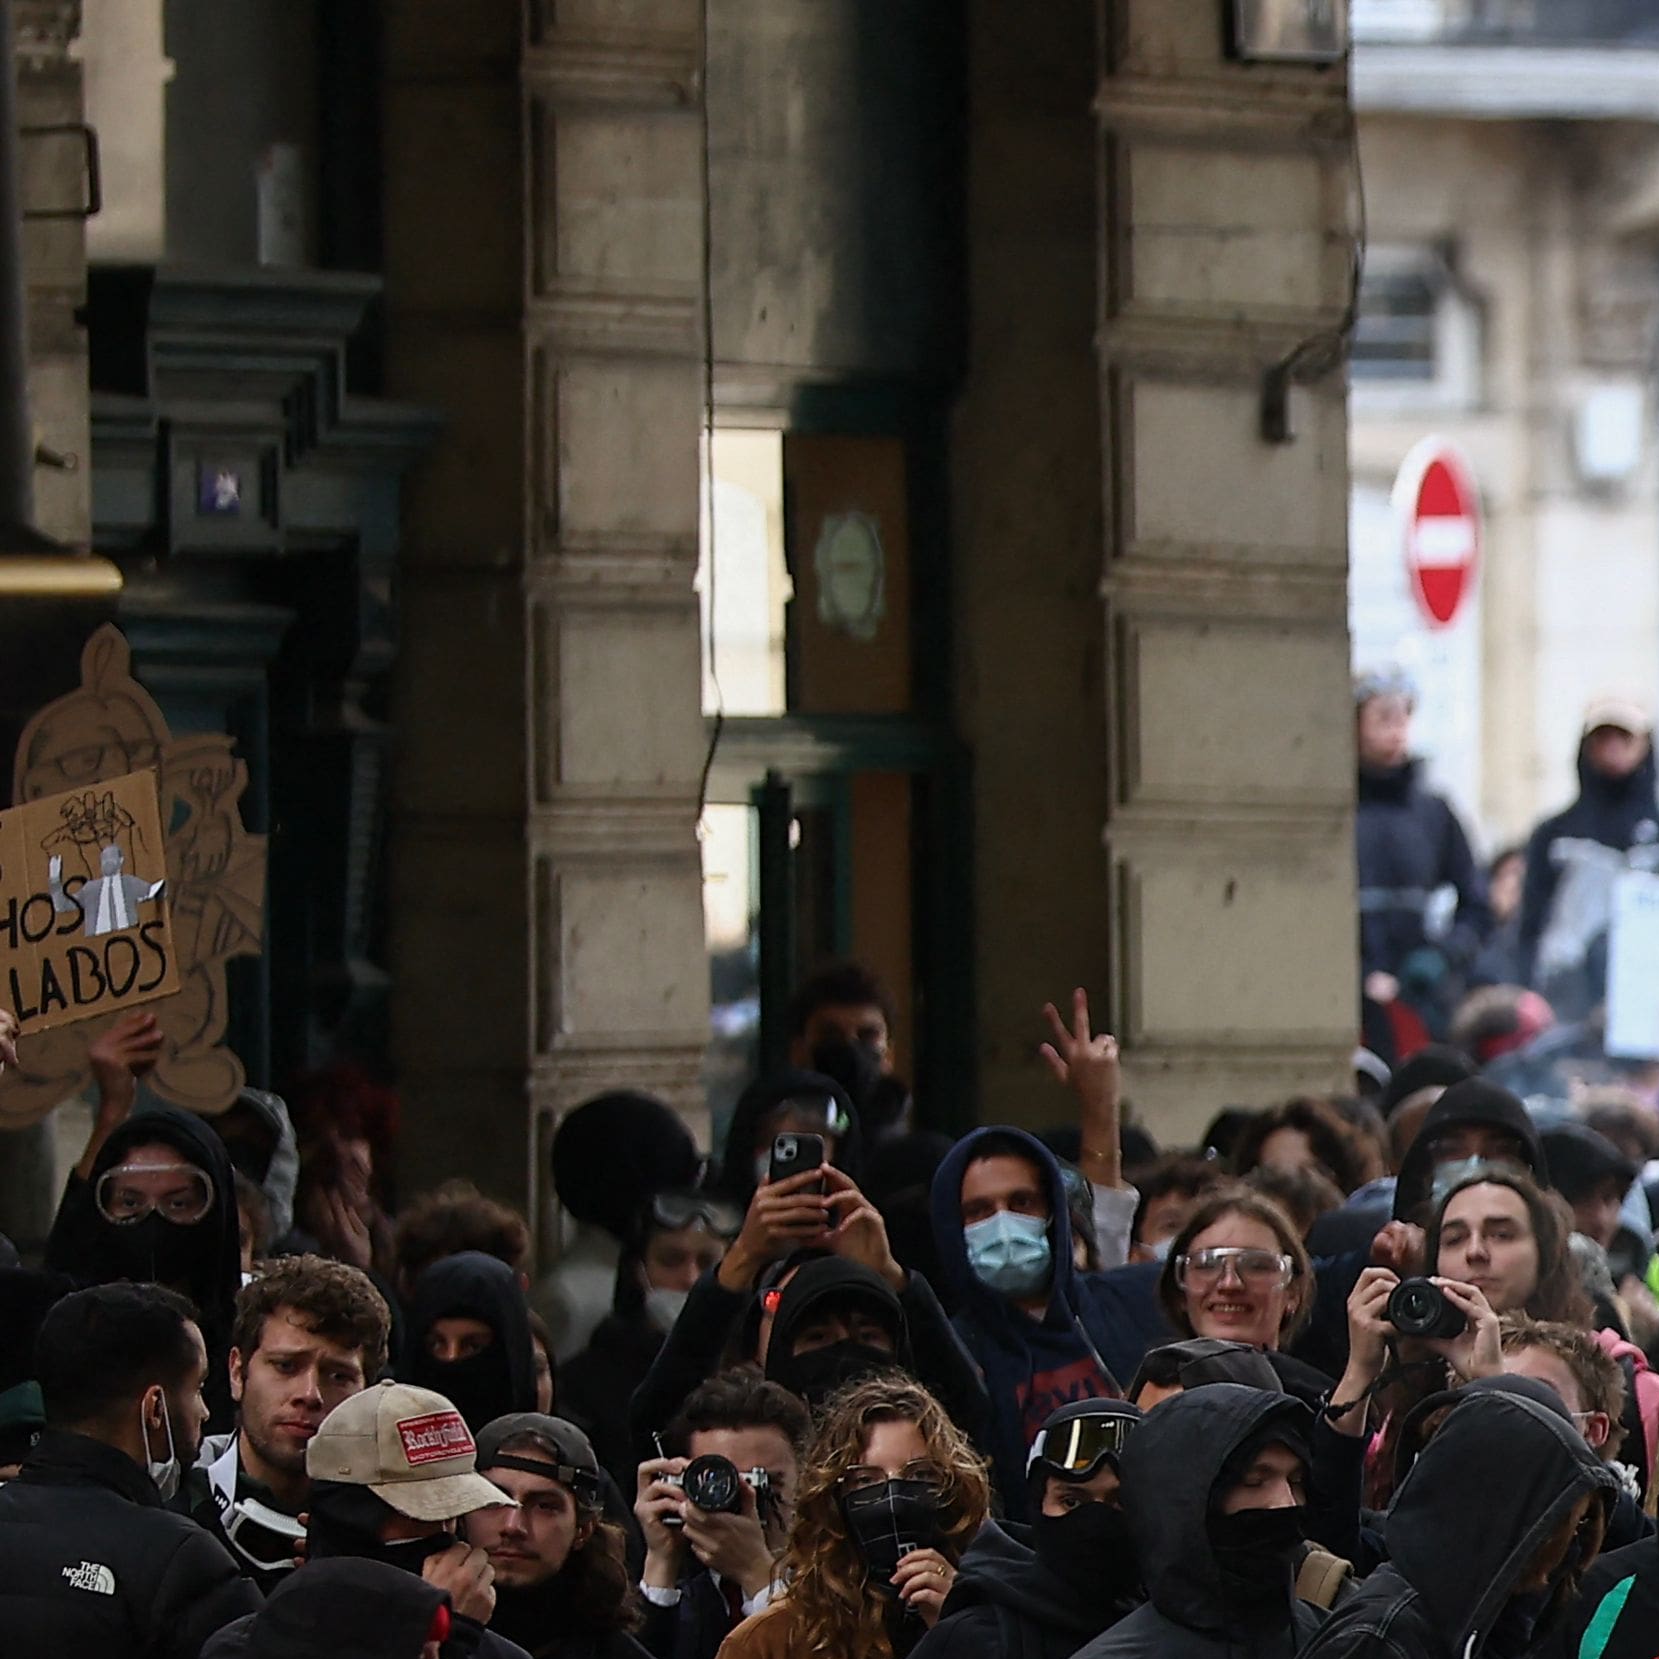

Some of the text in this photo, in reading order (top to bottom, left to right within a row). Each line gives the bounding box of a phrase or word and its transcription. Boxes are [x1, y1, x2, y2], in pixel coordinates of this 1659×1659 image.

[9, 920, 167, 1022] LABOS
[62, 1566, 98, 1583] NORTH
[81, 1561, 100, 1573] THE
[70, 1577, 96, 1591] FACE
